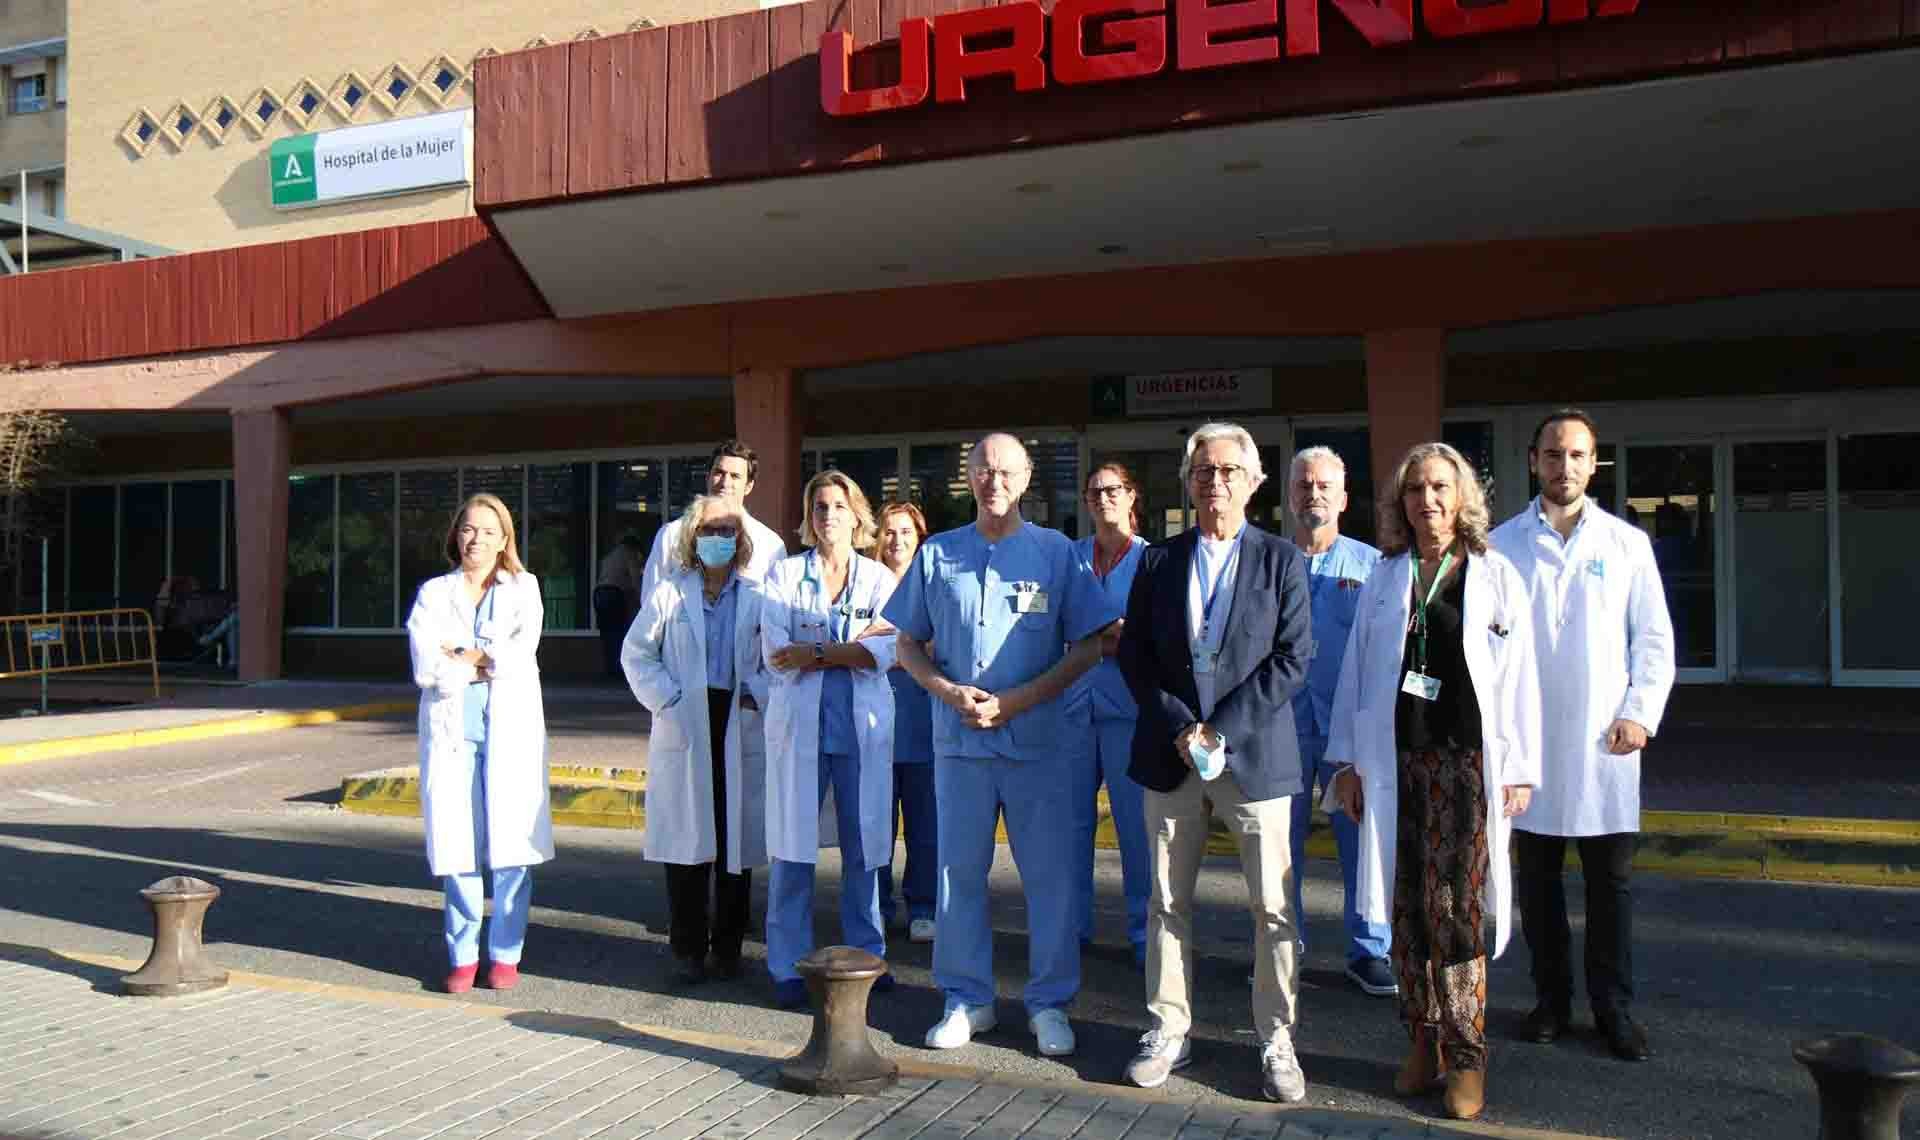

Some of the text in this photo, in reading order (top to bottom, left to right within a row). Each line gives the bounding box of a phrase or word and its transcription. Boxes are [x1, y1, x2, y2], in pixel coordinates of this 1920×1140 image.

[820, 0, 1640, 116] URGEN
[323, 138, 456, 169] Hospital de la Mujer
[1136, 375, 1240, 394] URGENCIAS
